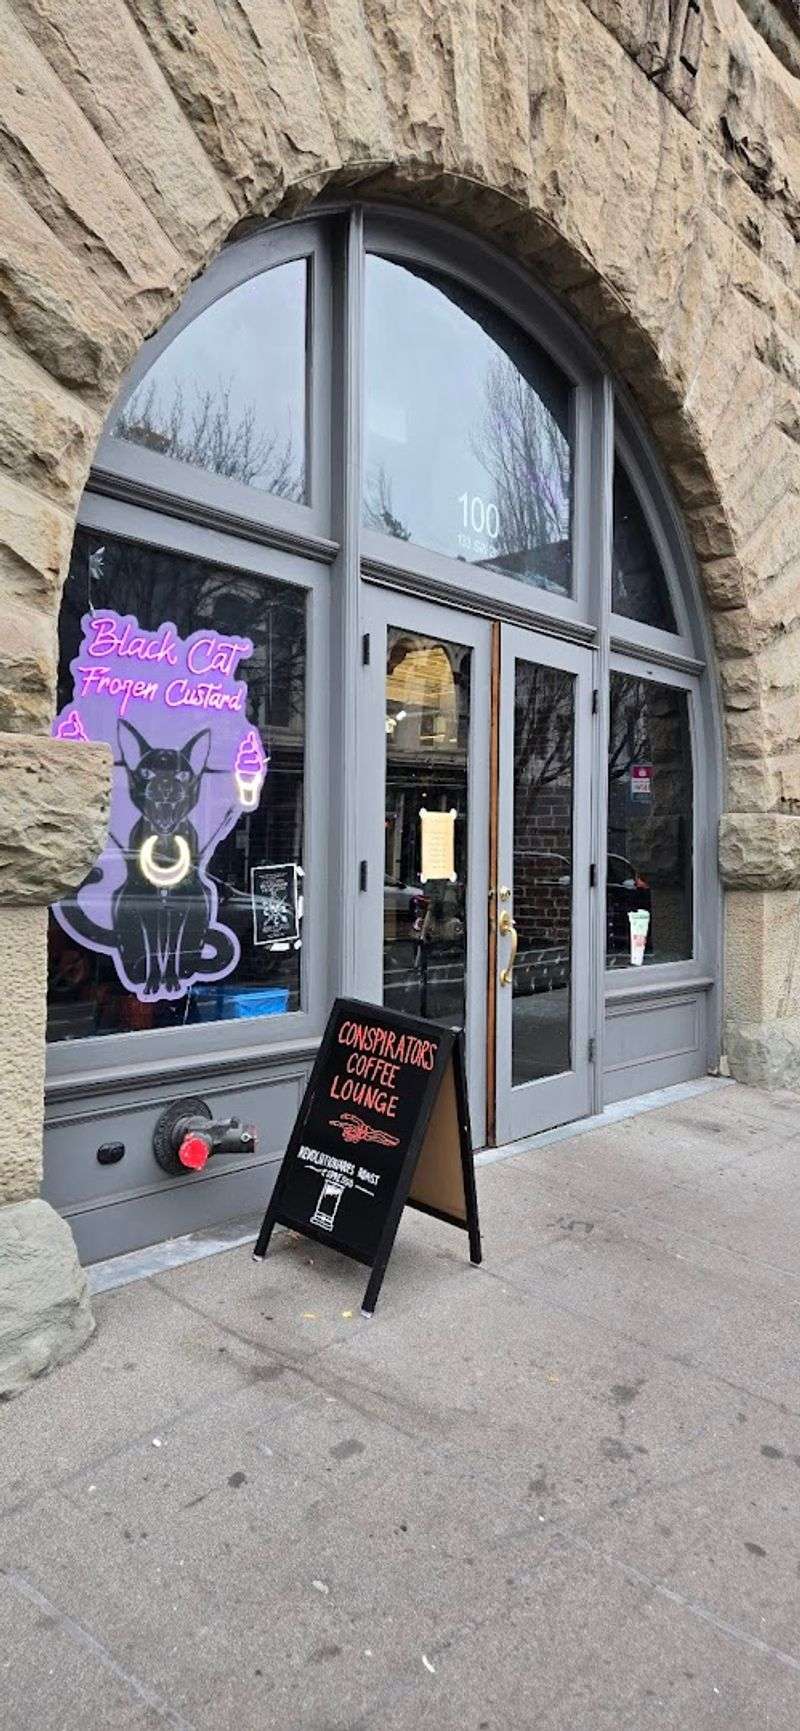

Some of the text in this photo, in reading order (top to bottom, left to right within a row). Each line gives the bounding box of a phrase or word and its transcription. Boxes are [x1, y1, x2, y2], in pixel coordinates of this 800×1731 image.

[458, 491, 499, 538] 100
[88, 618, 250, 676] Black Cat
[78, 667, 242, 717] Frozen Custard
[338, 1020, 438, 1071] CONSPIRATORS
[346, 1052, 400, 1089] COFFEE
[330, 1075, 399, 1118] LOUNGE
